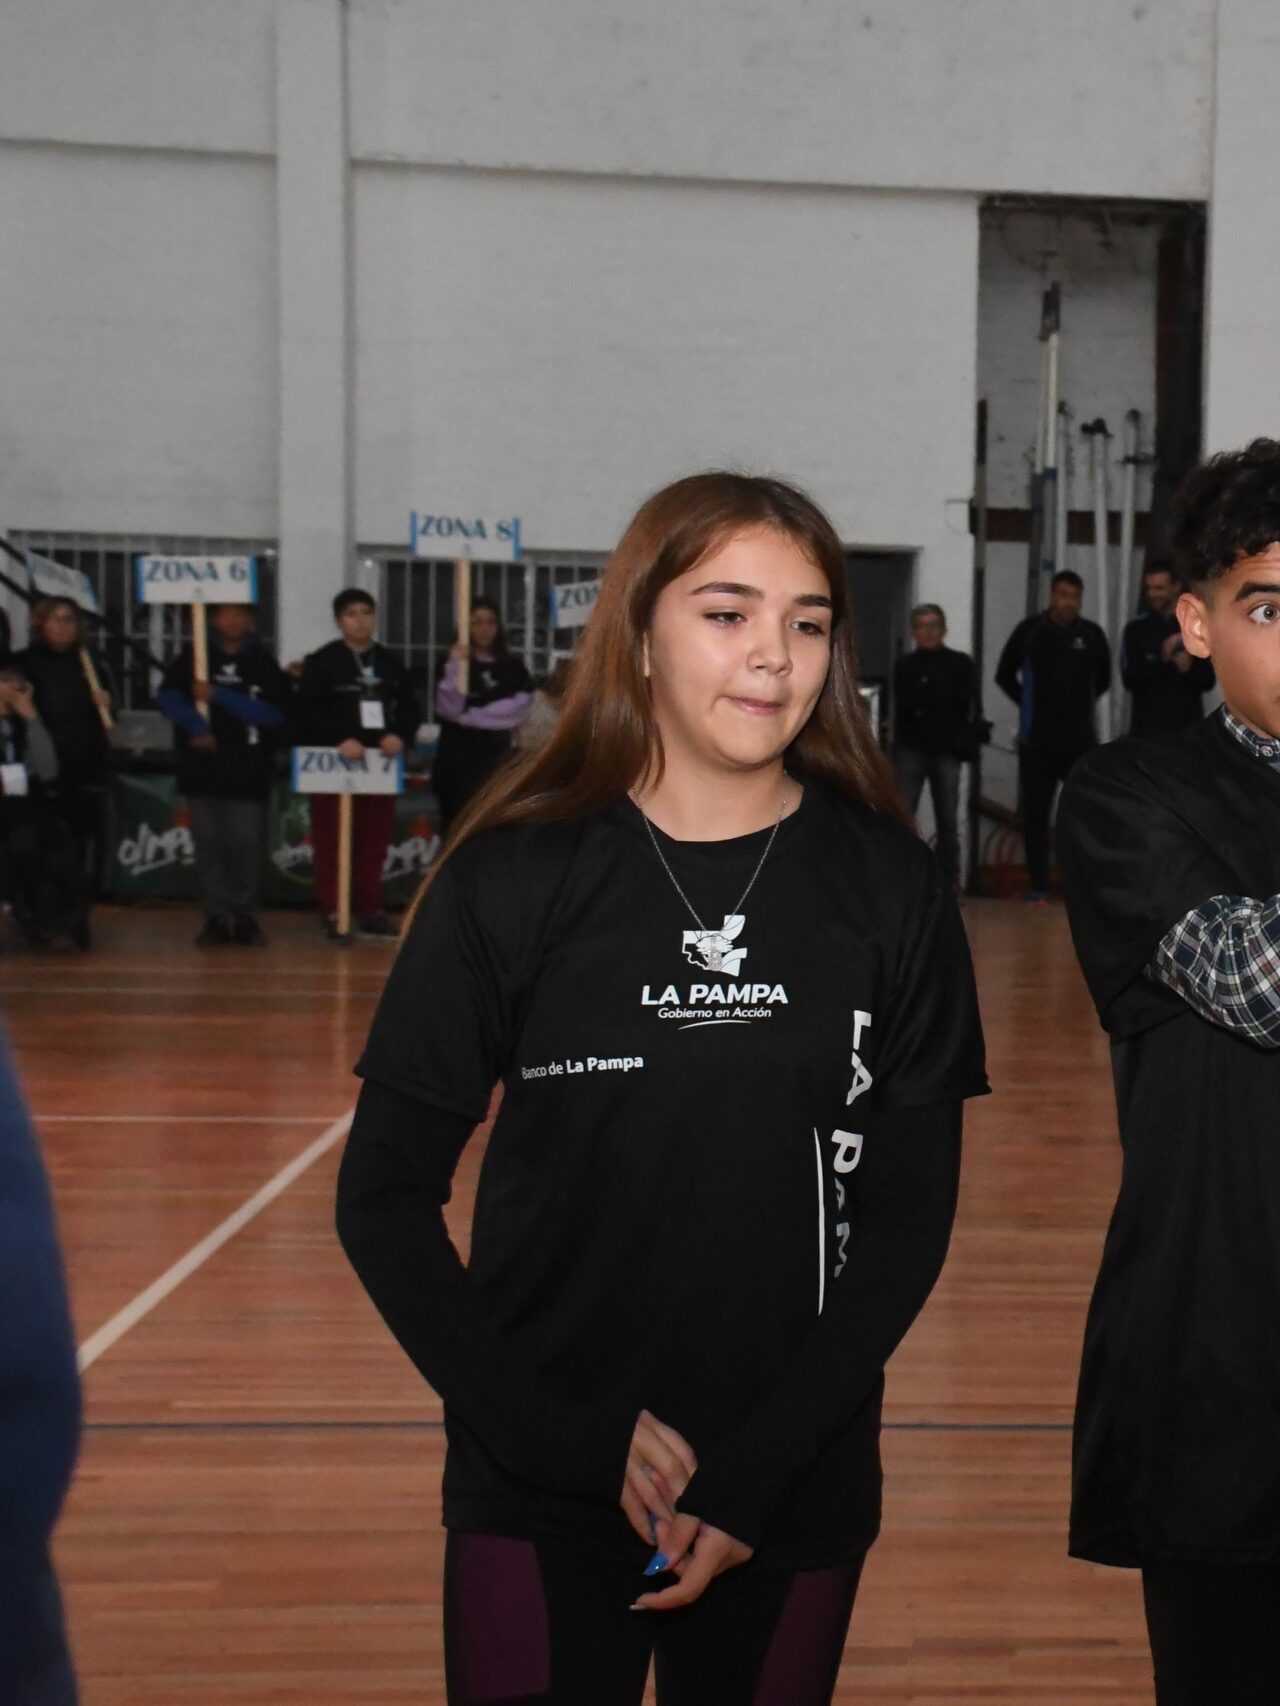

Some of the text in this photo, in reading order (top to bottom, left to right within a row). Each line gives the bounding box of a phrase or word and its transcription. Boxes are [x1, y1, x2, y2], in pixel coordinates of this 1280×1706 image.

[421, 515, 487, 539] ZONA
[144, 559, 247, 582] ZONA 6
[559, 584, 601, 609] ZON
[641, 983, 789, 1006] LA PAMPA
[657, 1006, 772, 1019] Gobierno en Acción
[521, 1056, 644, 1080] Banco de La Pampa
[846, 1009, 873, 1106] LA
